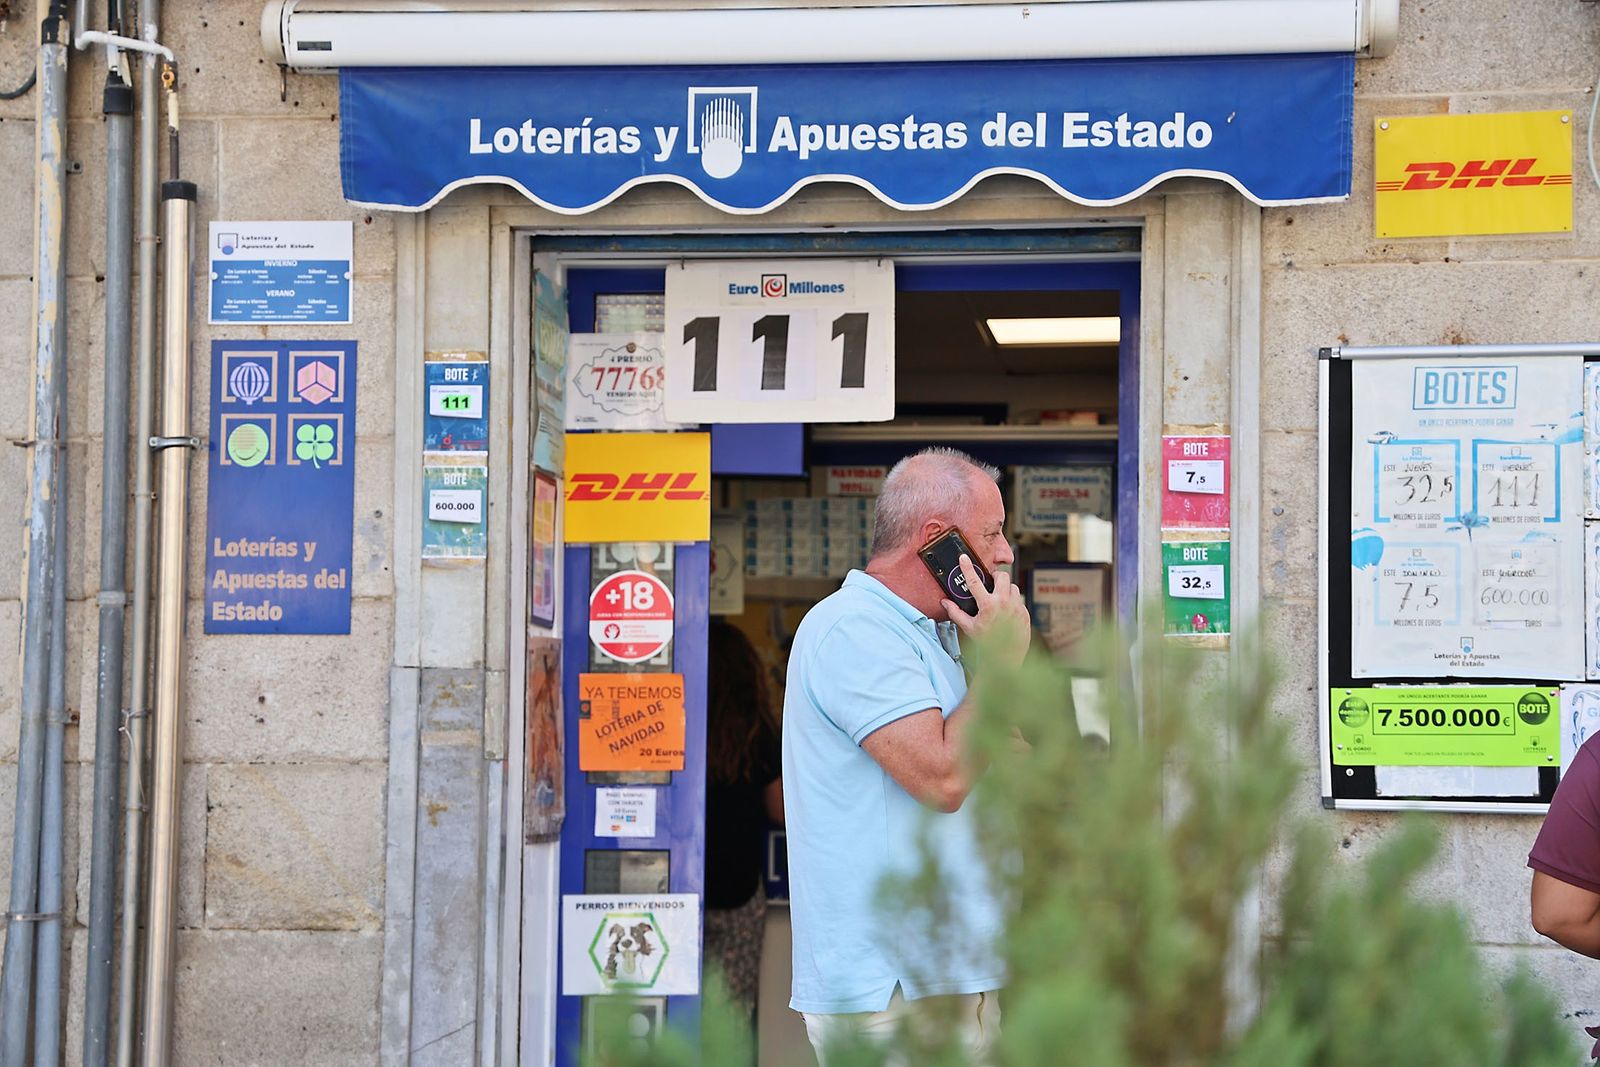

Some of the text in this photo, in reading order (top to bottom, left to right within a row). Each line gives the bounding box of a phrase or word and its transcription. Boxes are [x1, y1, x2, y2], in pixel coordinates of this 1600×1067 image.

[470, 112, 1213, 162] Loterías y Apuestas del Estado
[1401, 158, 1545, 191] DHL
[264, 260, 298, 268] INVIERNO
[729, 281, 845, 295] Euro Millones
[617, 355, 652, 363] PREMIO
[444, 368, 469, 382] BOTE
[1423, 371, 1508, 405] BOTES
[442, 396, 471, 409] 111
[1183, 442, 1209, 456] BOTE
[444, 473, 468, 486] BOTE
[1185, 471, 1206, 484] 7,5
[567, 473, 706, 501] DHL
[1395, 474, 1454, 506] 32,5
[1487, 473, 1539, 508] 111
[435, 502, 475, 511] 600.000
[1393, 513, 1417, 521] MILLONES
[1492, 515, 1516, 523] MILLONES
[214, 536, 317, 562] Loterías y
[1183, 547, 1209, 561] BOTE
[1384, 569, 1396, 577] ESTE
[1482, 569, 1495, 577] ESTE
[212, 568, 346, 594] Apuestas del
[1181, 576, 1212, 590] 32,5
[605, 581, 655, 611] +18
[1394, 582, 1439, 613] 7,5
[1481, 586, 1550, 606] 600.000
[212, 600, 283, 621] Estado
[1393, 619, 1417, 627] MILLONES
[1425, 619, 1442, 627] EUROS
[1469, 653, 1501, 661] Apuestas
[585, 686, 682, 699] YA TENEMOS
[1519, 703, 1548, 714] BOTE
[594, 700, 665, 739] LOTERIA DE
[608, 720, 665, 753] NAVIDAD
[640, 747, 685, 757] 20 Euros
[576, 901, 685, 910] PERROS BIENVENIDOS
